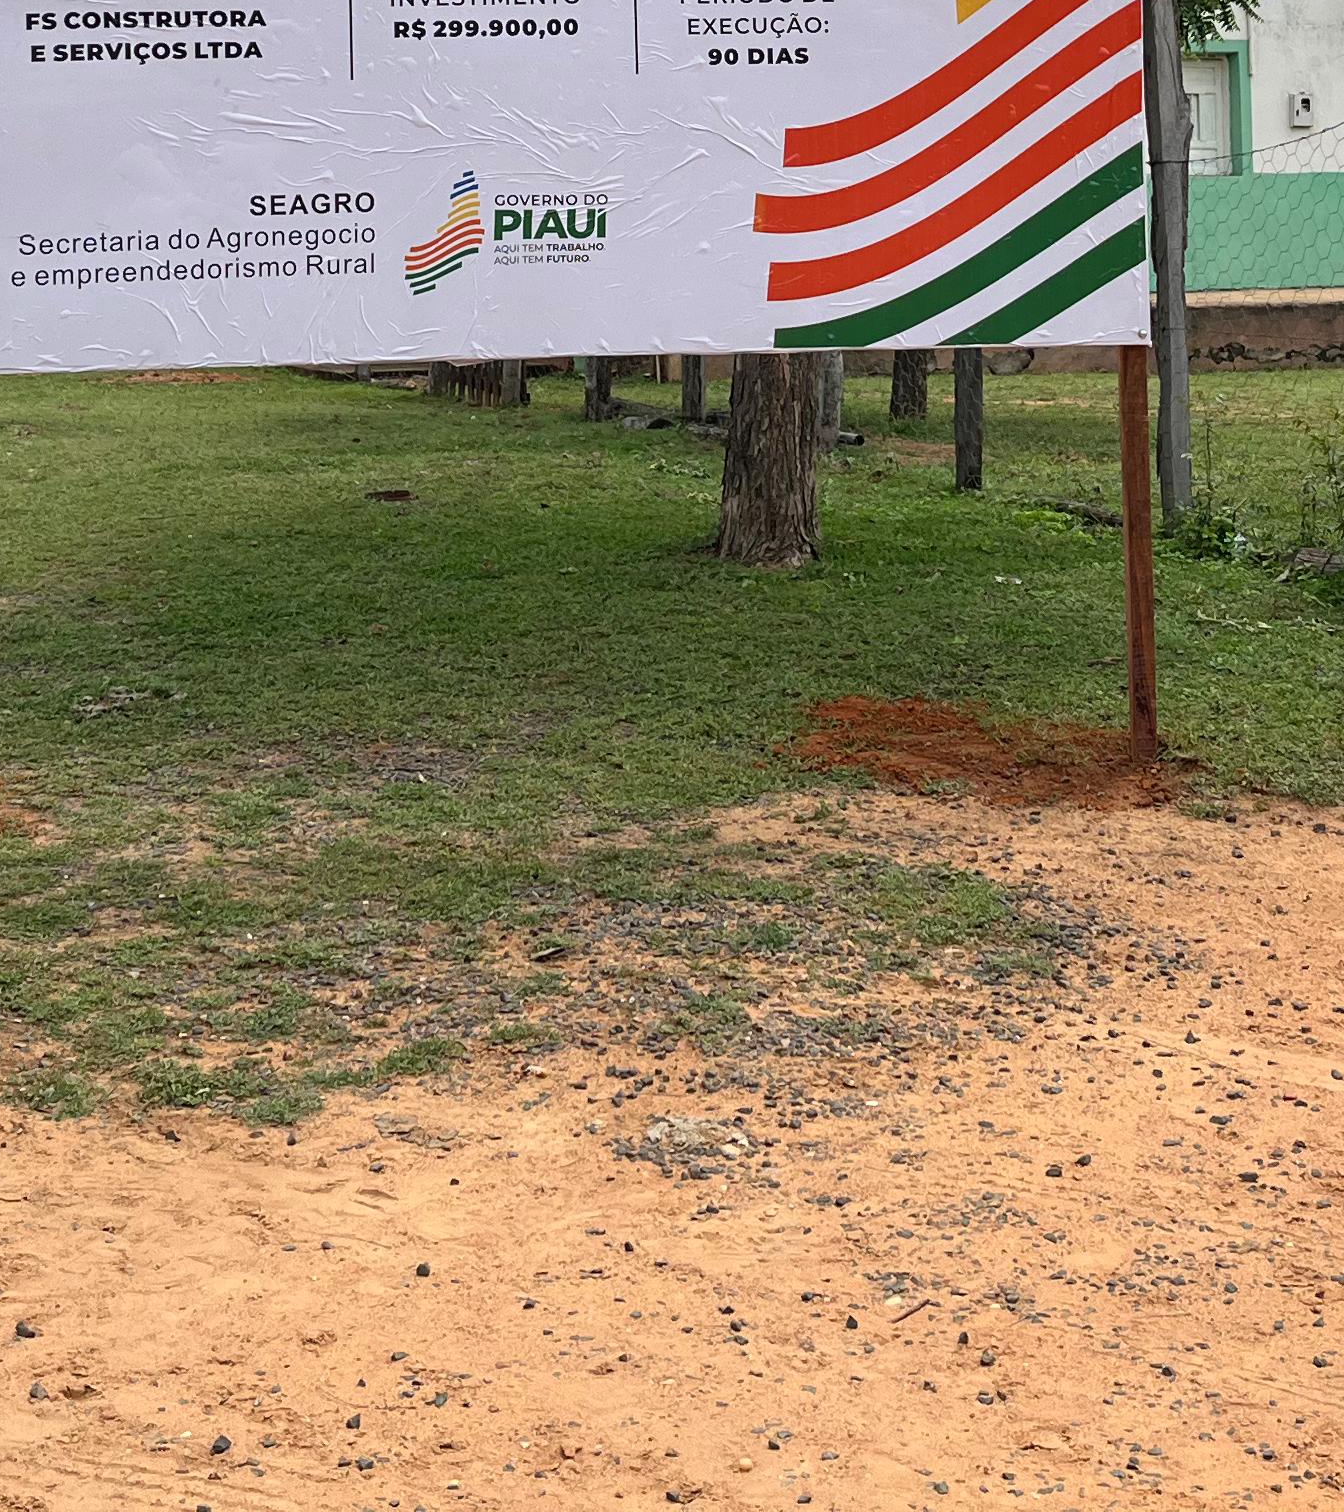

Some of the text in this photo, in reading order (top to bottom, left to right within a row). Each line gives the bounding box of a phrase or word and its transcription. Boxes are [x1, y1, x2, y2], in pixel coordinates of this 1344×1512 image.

[25, 9, 267, 31] FS CONSTRUTORA
[393, 18, 579, 41] R$ 299.900,00
[687, 12, 829, 39] EXECUÇÃO:
[30, 41, 263, 66] E SERVIÇOS LTDA
[707, 47, 809, 66] 90 DIAS
[249, 191, 375, 216] SEAGRO
[494, 193, 608, 206] GOVERNO DO
[493, 208, 606, 240] PIAUÍ
[18, 222, 376, 256] Secretaria do Agronegocio
[494, 244, 520, 253] AQUI
[522, 243, 543, 252] TEM
[11, 253, 375, 290] e empreendedorismo Rural
[494, 256, 520, 265] AQUI
[522, 255, 543, 264] TEM
